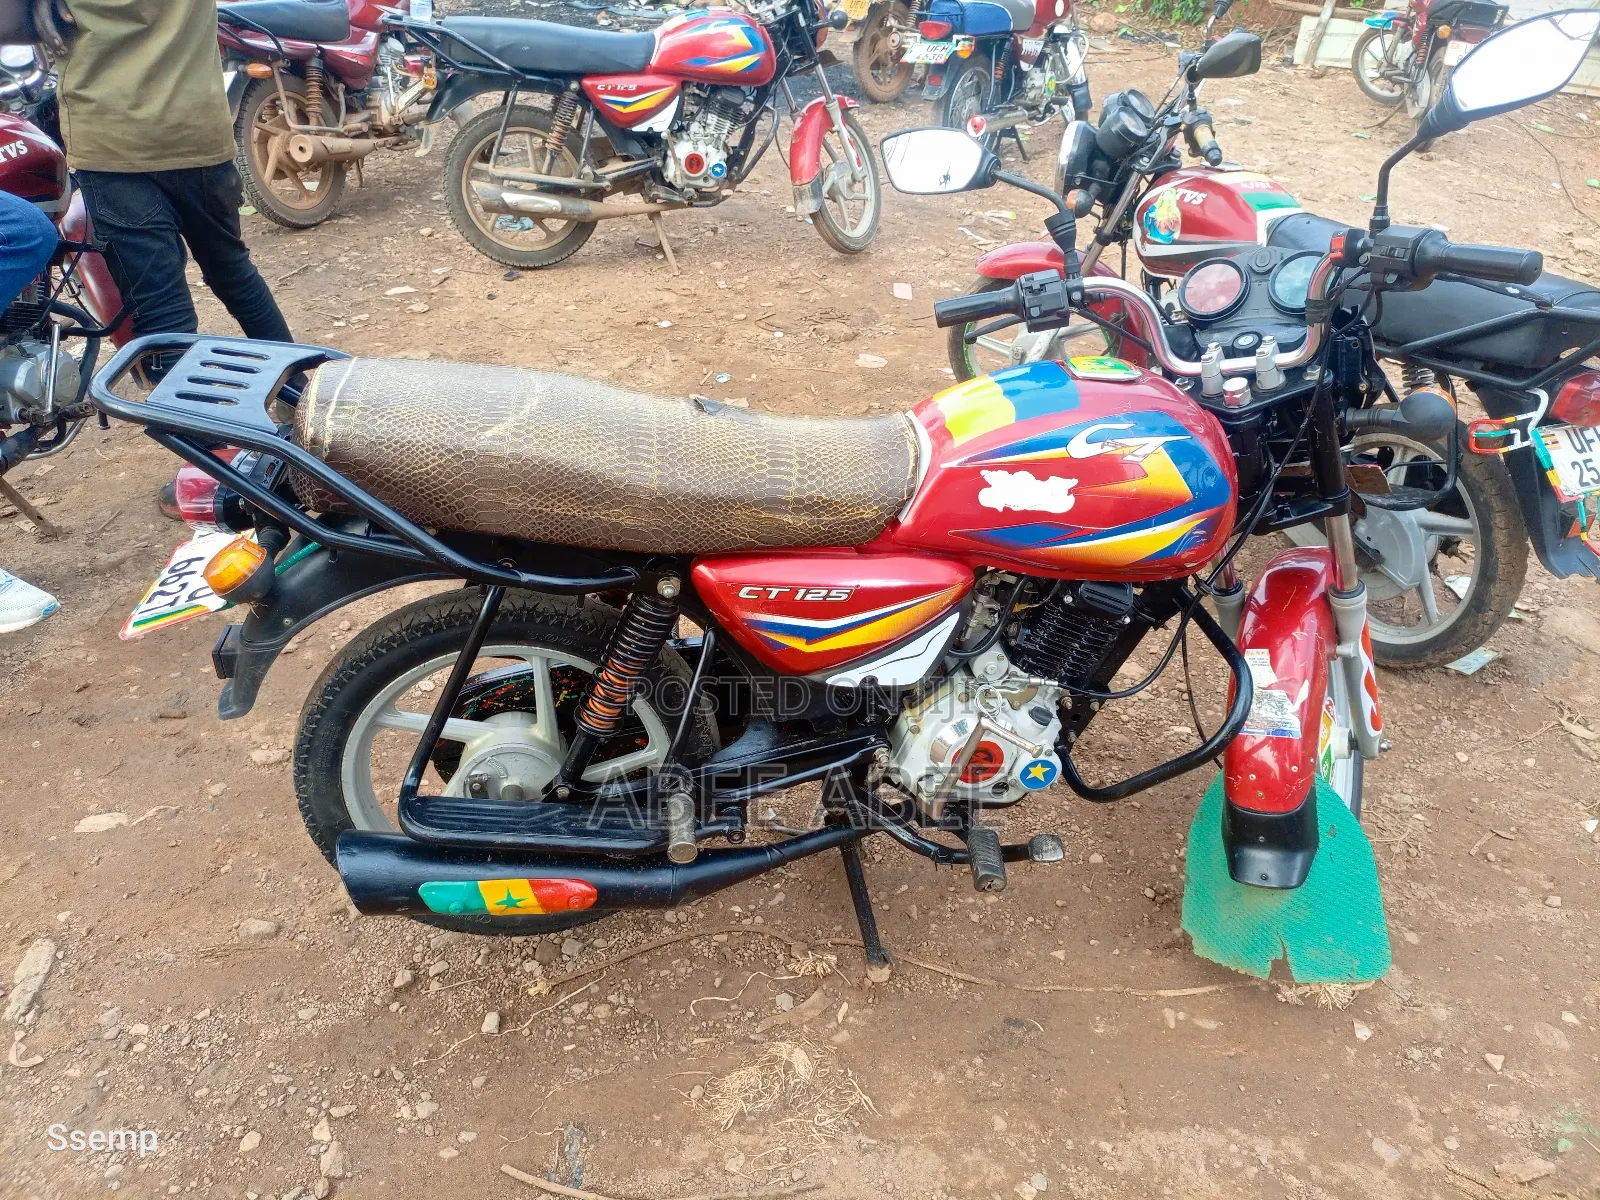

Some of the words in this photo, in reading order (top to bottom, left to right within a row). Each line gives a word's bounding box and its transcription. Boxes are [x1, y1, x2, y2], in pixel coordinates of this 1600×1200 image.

[1175, 188, 1208, 205] TVS
[738, 586, 791, 600] CT
[793, 588, 852, 601] 125
